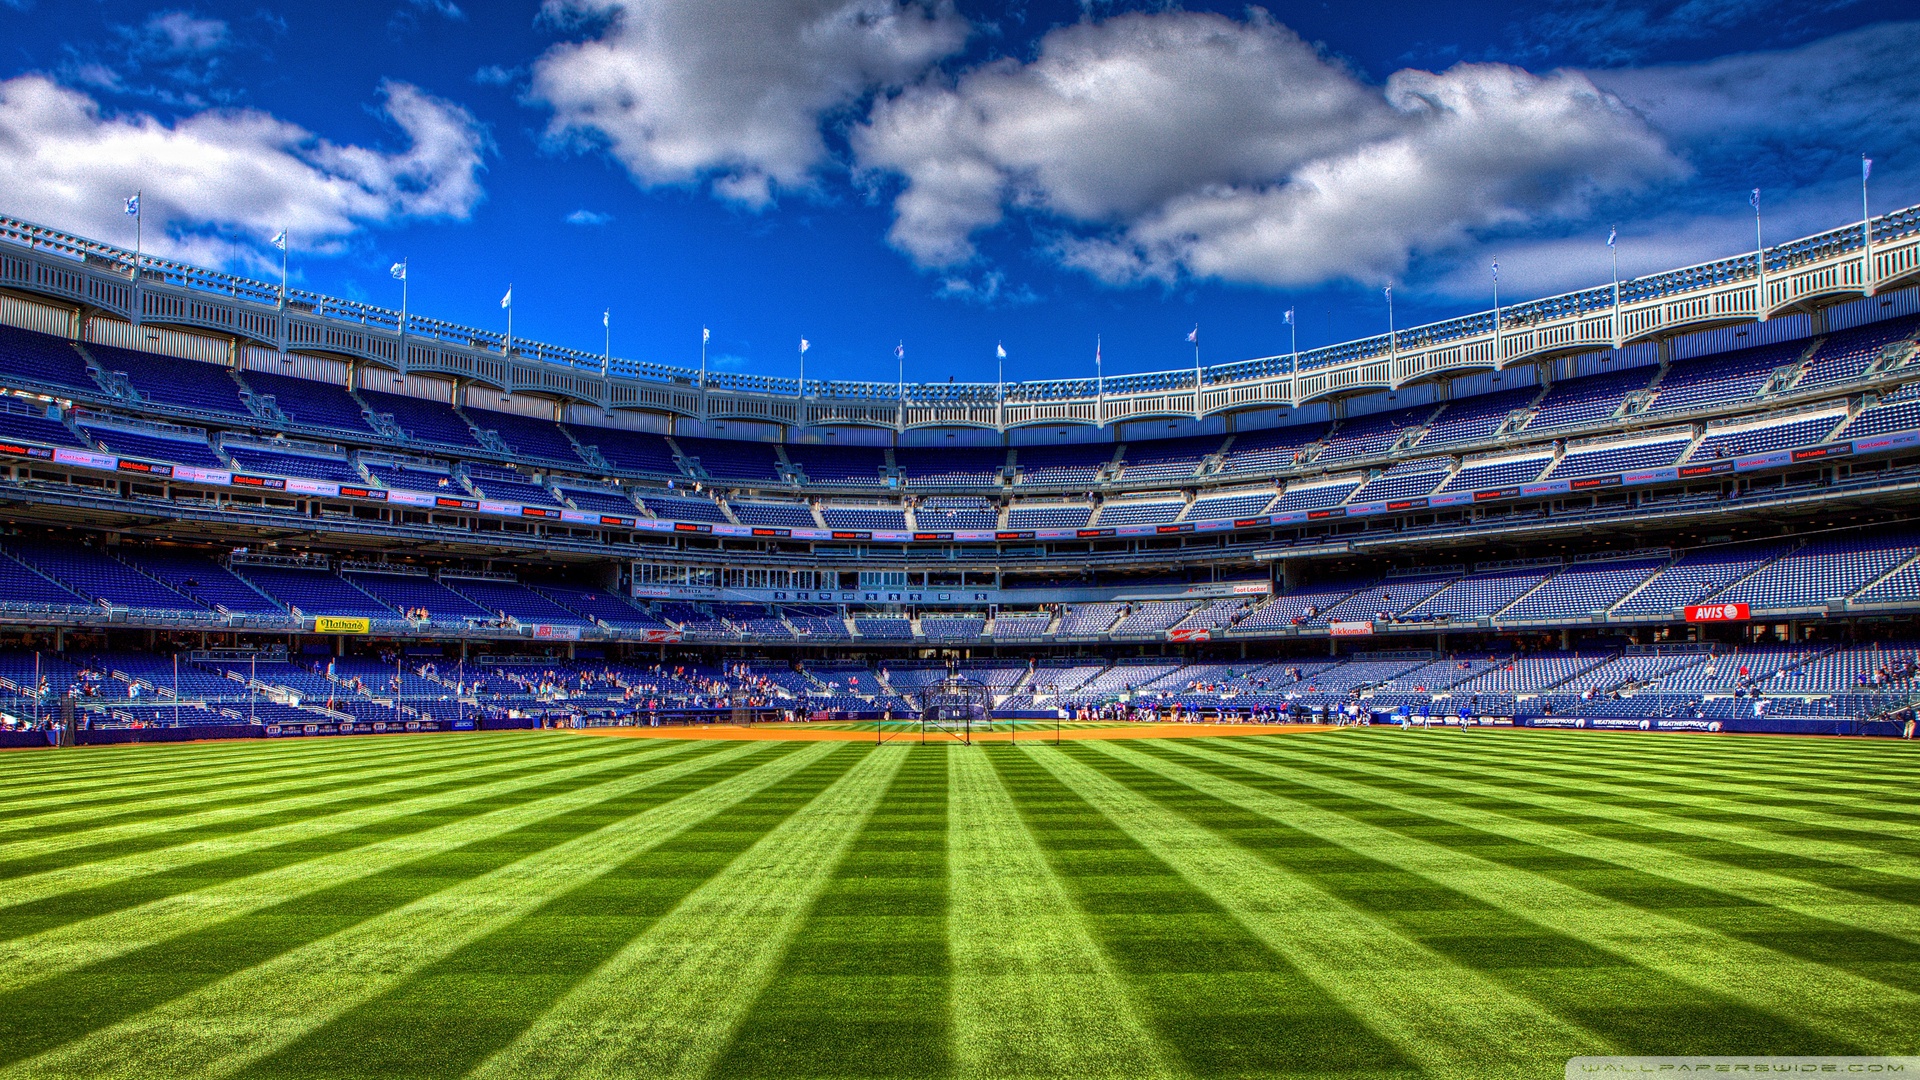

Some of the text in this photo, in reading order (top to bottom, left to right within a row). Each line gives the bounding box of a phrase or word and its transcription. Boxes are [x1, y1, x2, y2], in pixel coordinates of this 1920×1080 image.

[1871, 440, 1890, 448] Locker
[1695, 607, 1723, 619] AVIS
[321, 619, 363, 631] Nathan's
